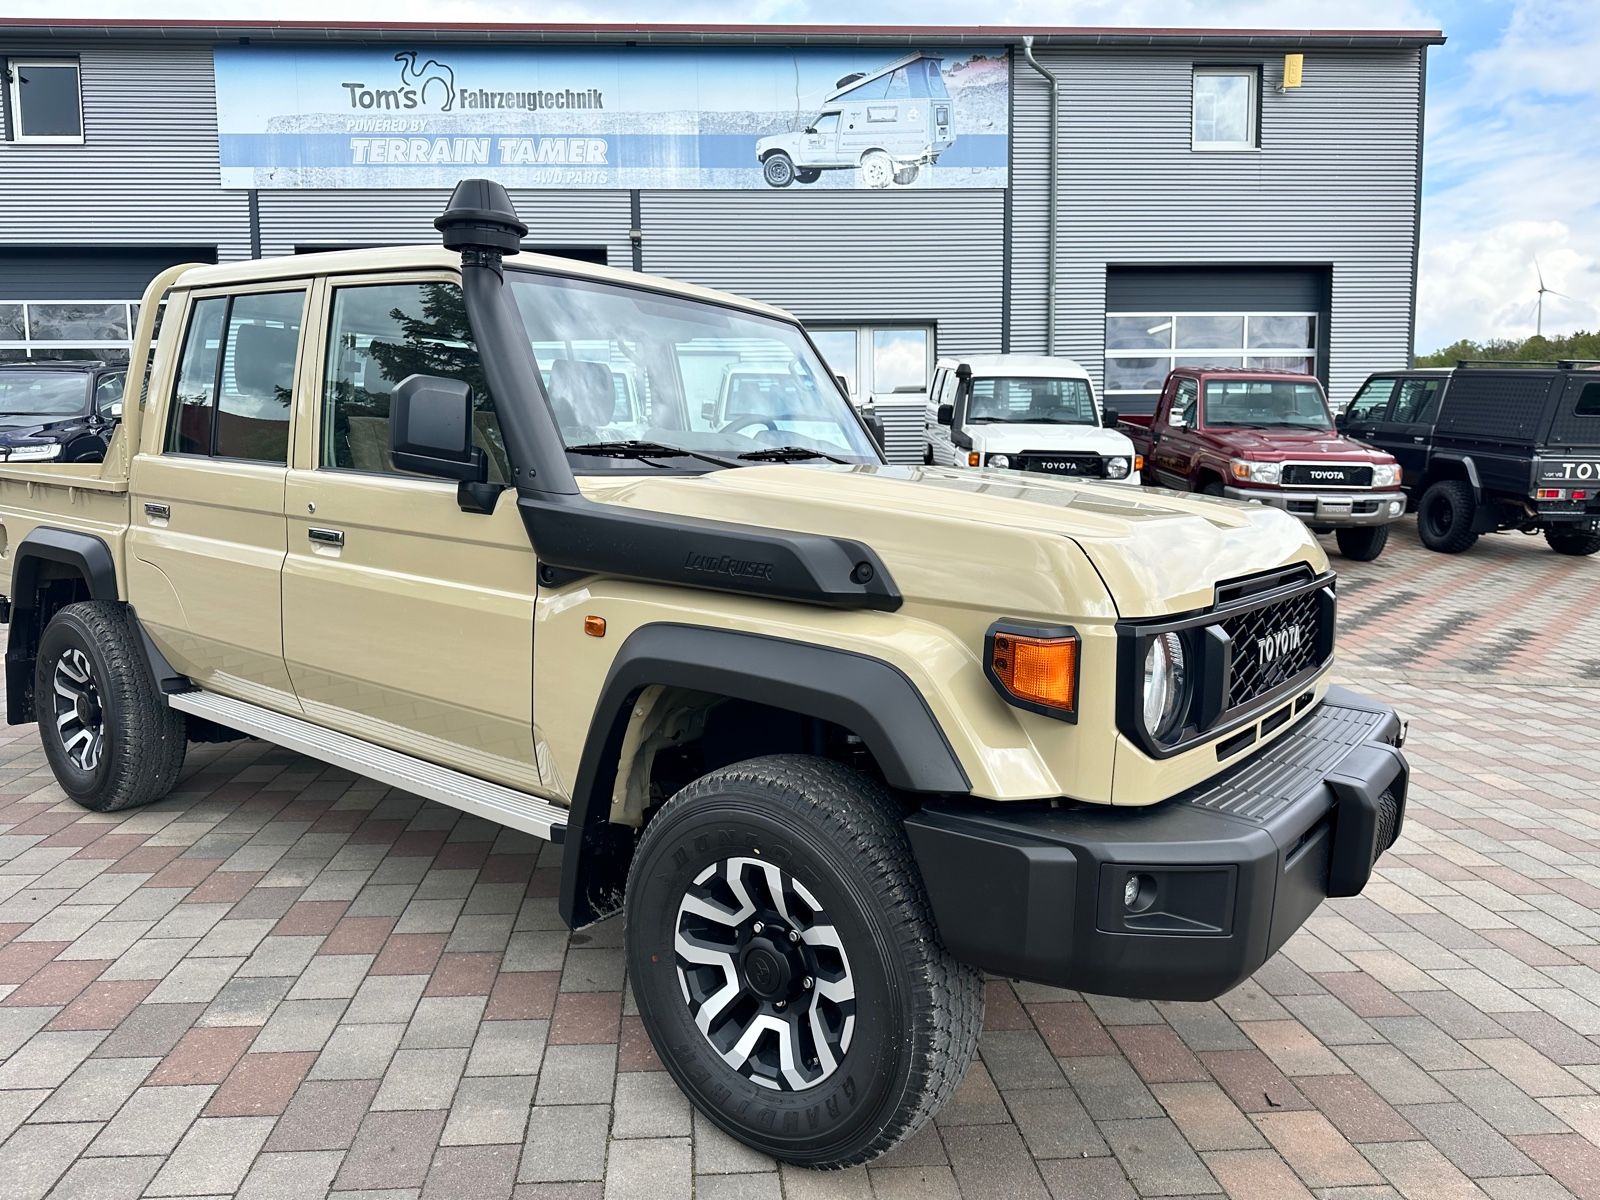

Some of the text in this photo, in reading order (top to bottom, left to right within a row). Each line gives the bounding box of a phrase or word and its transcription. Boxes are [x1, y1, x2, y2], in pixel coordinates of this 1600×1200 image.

[341, 82, 604, 111] Tom's Fahrzeugtechnik
[346, 119, 428, 132] POWERED BY
[350, 137, 609, 164] TERRAIN TAMER
[534, 170, 609, 184] 4WD PARTS
[1041, 462, 1077, 470] TOYOTA
[1309, 470, 1345, 480] TOYOTA
[1256, 623, 1300, 665] TOYOTA
